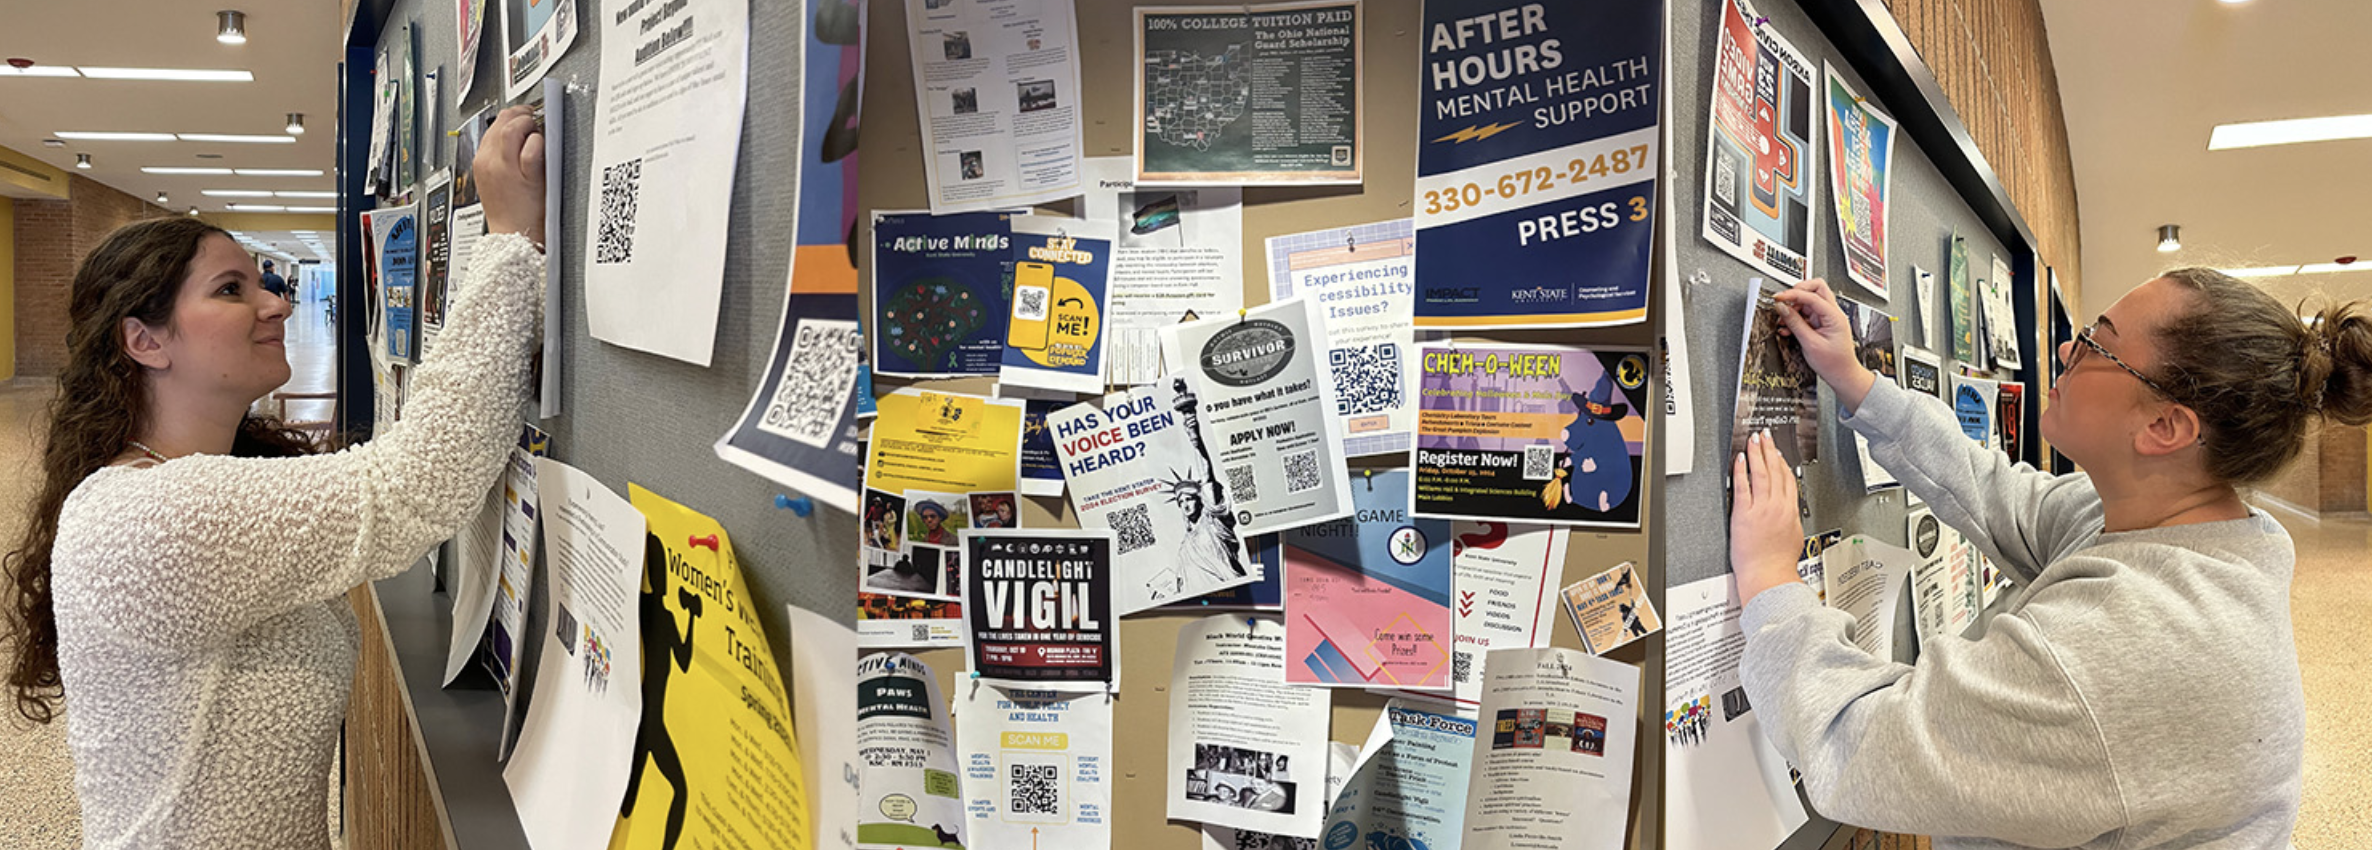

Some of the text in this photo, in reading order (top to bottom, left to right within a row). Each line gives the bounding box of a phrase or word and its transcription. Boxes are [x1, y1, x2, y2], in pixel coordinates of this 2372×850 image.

[1148, 10, 1352, 30] 100% COLLEGE TUITION PAID
[1430, 3, 1548, 52] AFTER
[1255, 25, 1350, 40] The Ohio National
[1255, 36, 1350, 50] Guard Scholarship
[1432, 38, 1563, 91] HOURS
[1436, 56, 1649, 120] MENTAL HEALTH
[1534, 84, 1651, 129] SUPPORT
[1424, 144, 1649, 215] 330-672-2487
[1518, 196, 1648, 246] PRESS 3
[893, 234, 1010, 252] Active Minds
[1028, 246, 1093, 264] CONNECTED
[1304, 264, 1408, 288] Experiencing
[1319, 282, 1413, 303] cessibility
[1058, 314, 1082, 322] SCAN
[1328, 301, 1390, 318] Issues?
[1212, 340, 1286, 366] SURVIVOR
[1424, 352, 1561, 379] CHEM-O-WEEN
[1214, 400, 1230, 412] you
[1232, 395, 1252, 406] have
[1254, 390, 1276, 402] what
[1276, 386, 1284, 397] it
[1284, 378, 1311, 394] takes?
[1422, 388, 1474, 400] Celebrating
[1476, 388, 1522, 400] Halloween
[1057, 396, 1156, 439] HAS YOUR
[1063, 427, 1125, 458] VOICE
[1126, 411, 1174, 440] BEEN
[1230, 428, 1264, 446] APPLY
[1266, 420, 1296, 438] NOW!
[1069, 442, 1146, 478] HEARD?
[1418, 450, 1518, 468] Register Now!
[1100, 491, 1134, 506] ELECTION
[1134, 483, 1162, 498] SURVEY
[1114, 484, 1130, 494] KENT
[1356, 510, 1404, 523] GAME
[1300, 524, 1359, 538] NIGHT!!
[668, 547, 734, 612] Women's
[982, 559, 1094, 580] CANDLELIGHT
[1489, 589, 1509, 597] FOOD
[983, 579, 1100, 630] VIGIL
[1487, 600, 1516, 610] FRIENDS
[1486, 610, 1510, 620] VIDEOS
[1374, 628, 1396, 641] Come
[1414, 632, 1434, 642] some
[1484, 621, 1522, 632] DISCUSSION
[1478, 638, 1490, 646] US
[876, 688, 912, 698] PAWS
[1008, 712, 1058, 722] AND HEALTH
[1390, 710, 1474, 736] Task Force
[1008, 734, 1060, 746] SCAN ME
